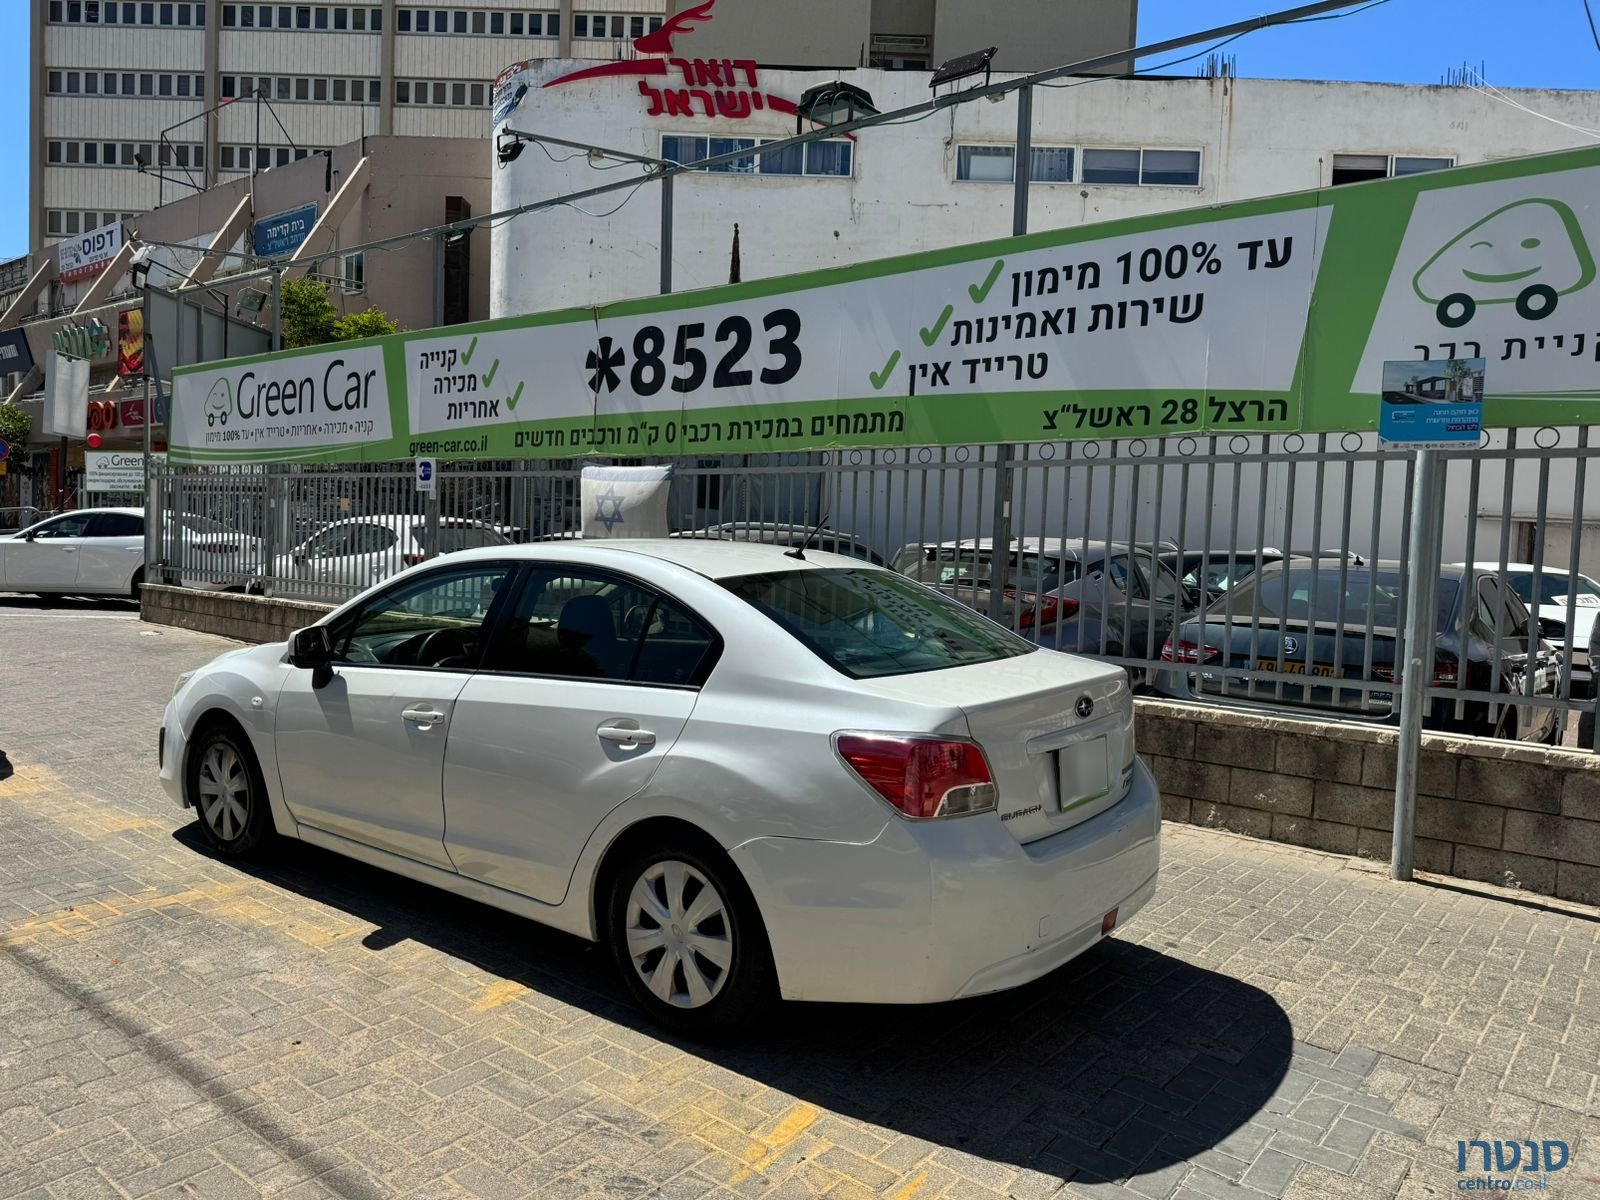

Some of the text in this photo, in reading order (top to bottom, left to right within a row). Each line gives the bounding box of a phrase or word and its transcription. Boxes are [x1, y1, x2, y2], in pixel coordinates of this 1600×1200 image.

[669, 57, 758, 88] דואר
[638, 81, 764, 119] ישראל
[267, 219, 305, 240] בית קדימה
[82, 229, 115, 256] דפוס
[1012, 235, 1294, 306] עד 100% מימון
[950, 293, 1204, 346] שירות ואמינות
[419, 347, 458, 371] קנייה
[433, 373, 477, 395] מכירה
[907, 351, 1048, 396] טרייד אין
[236, 358, 376, 419] Green Car
[447, 398, 500, 421] אחריות
[1160, 399, 1199, 424] 28
[1208, 397, 1288, 424] הרצל
[665, 421, 677, 443] 0
[681, 423, 723, 443] רכבי
[729, 419, 804, 443] במכירת
[810, 410, 905, 437] מתמחים
[408, 434, 488, 457] green-car.co.il
[513, 430, 565, 448] חדשים
[569, 426, 622, 448] ורכבים
[111, 454, 144, 467] Green
